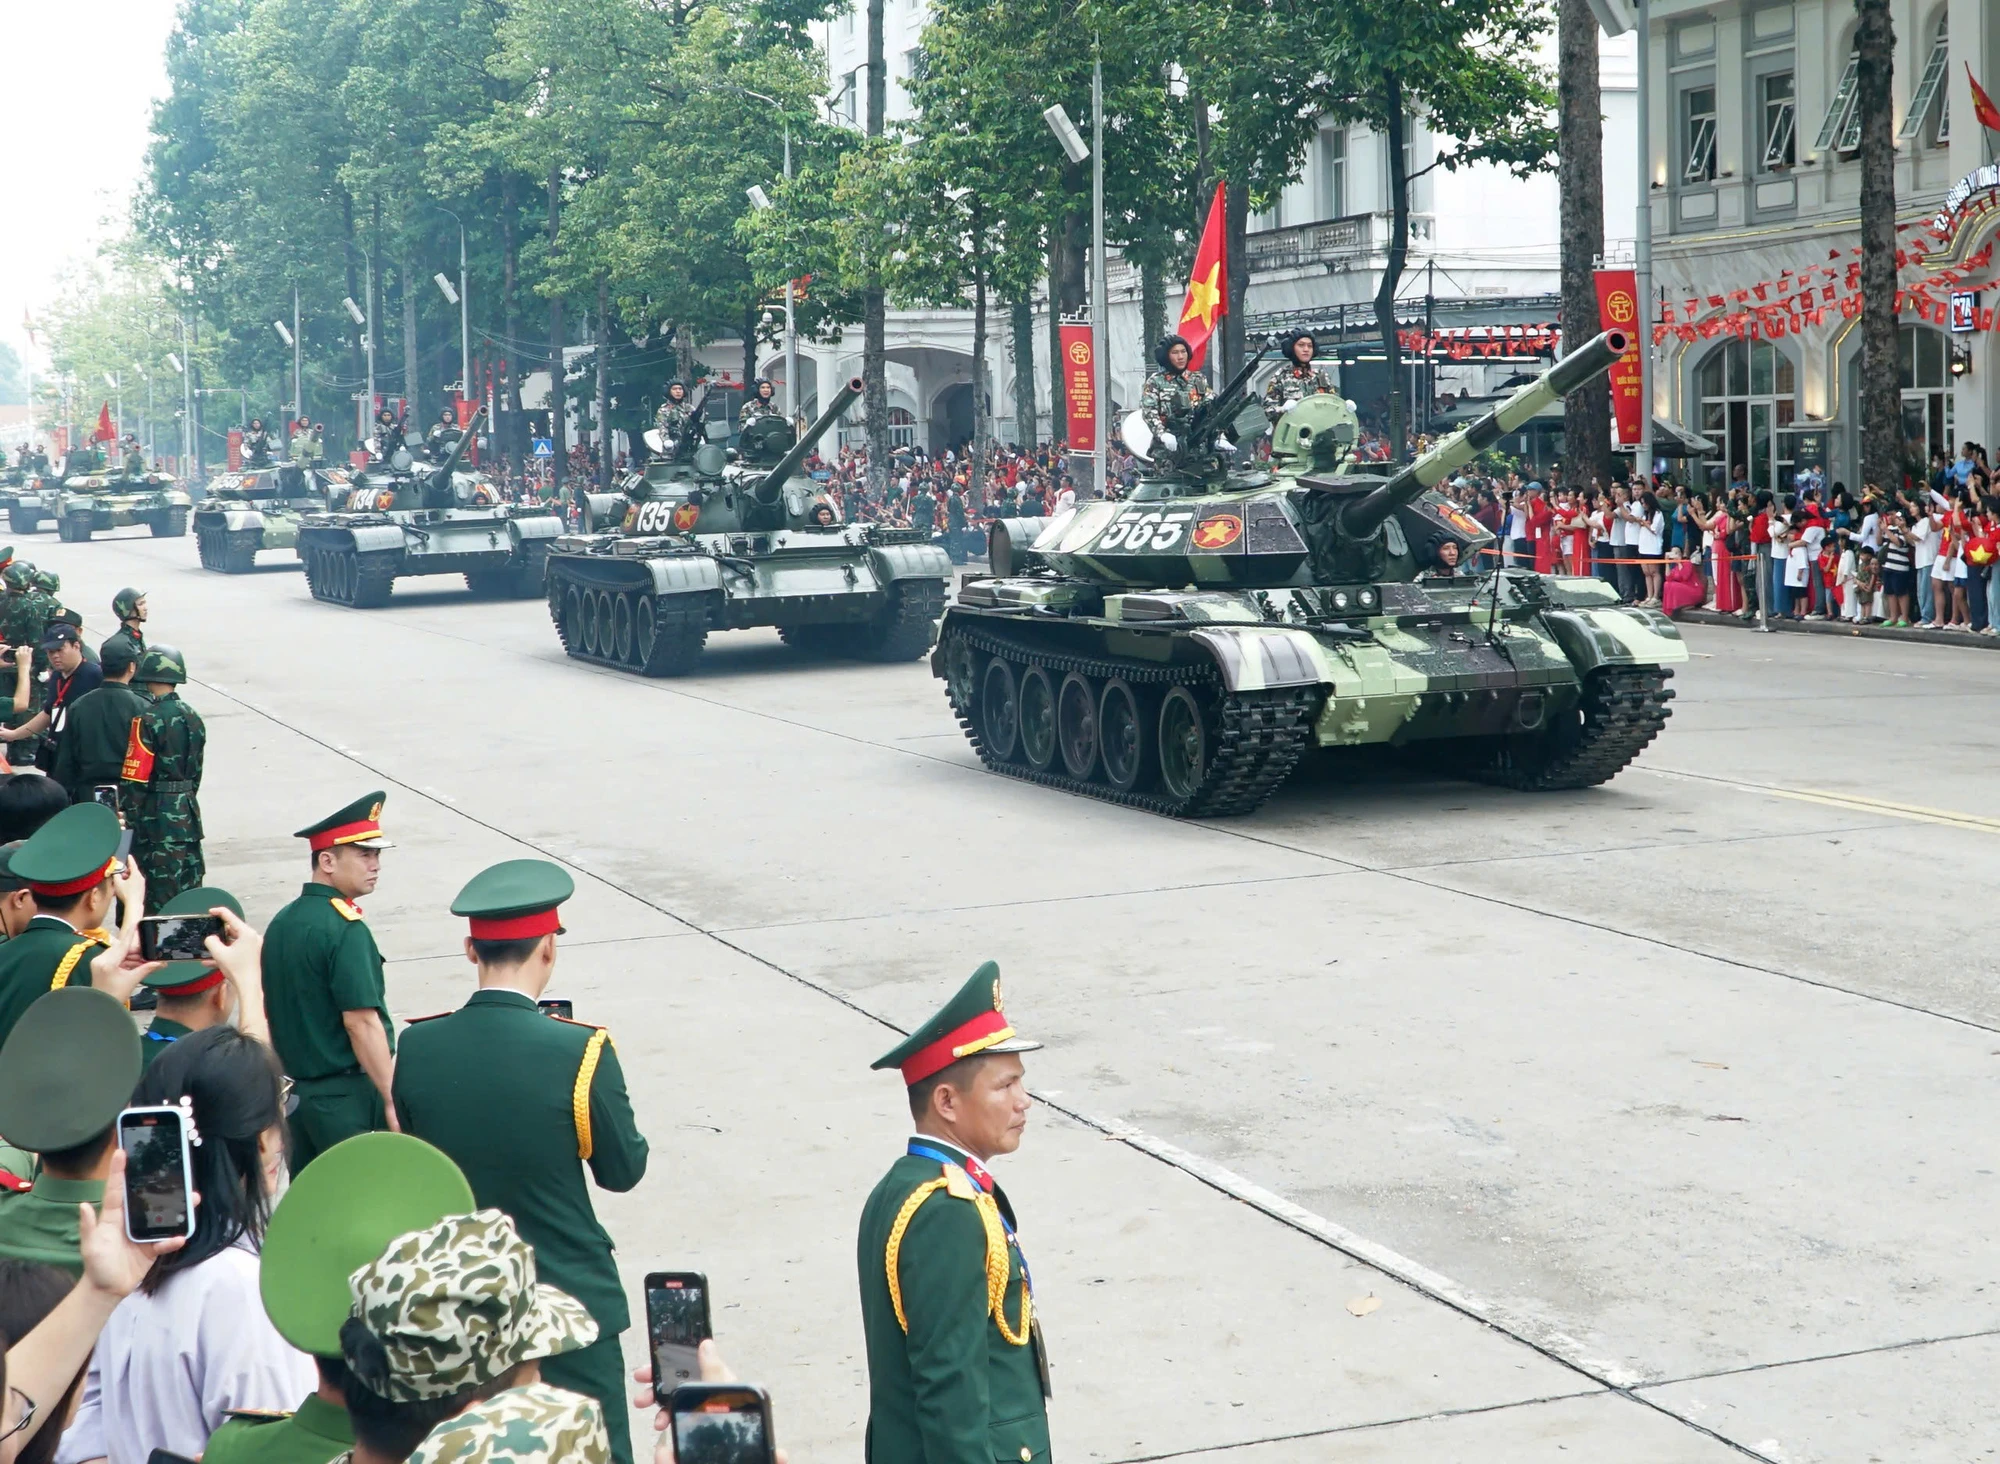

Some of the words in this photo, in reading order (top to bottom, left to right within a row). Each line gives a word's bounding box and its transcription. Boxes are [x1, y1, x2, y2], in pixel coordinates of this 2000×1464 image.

[353, 488, 379, 510] 134
[637, 501, 676, 532] 135
[1100, 512, 1194, 550] 565
